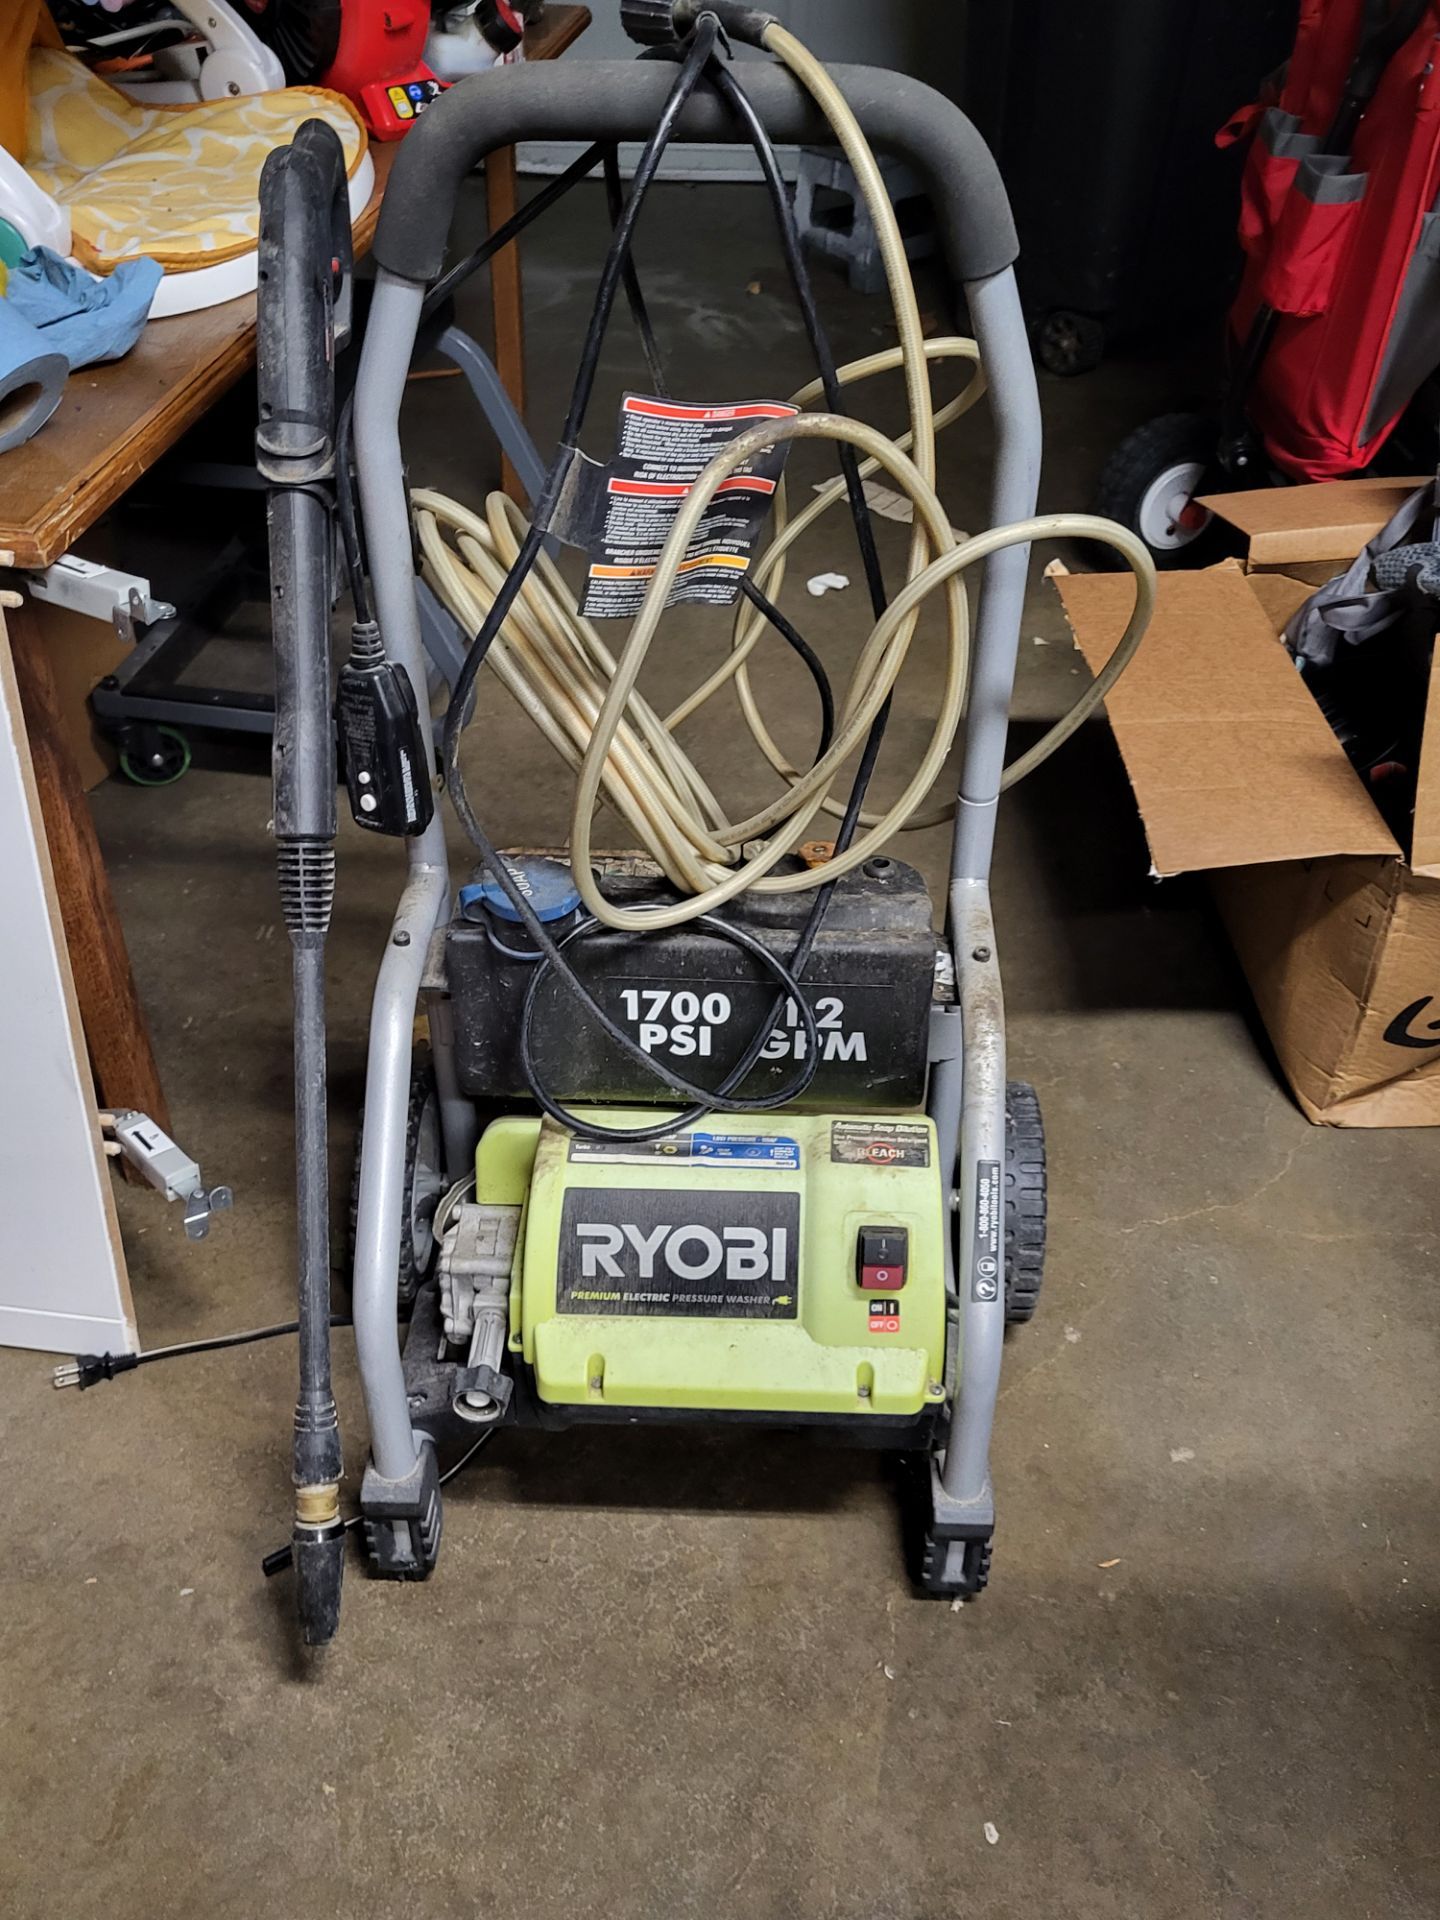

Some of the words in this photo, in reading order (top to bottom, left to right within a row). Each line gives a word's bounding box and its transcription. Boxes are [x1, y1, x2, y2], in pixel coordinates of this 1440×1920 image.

[619, 990, 731, 1025] 1700
[639, 1024, 712, 1056] PSI
[873, 1123, 895, 1133] Soap
[979, 1178, 990, 1238] 1-800-860-4050
[990, 1167, 999, 1251] www.ryobitools.com
[576, 1223, 787, 1282] RYOBI
[570, 1291, 621, 1301] PREMIUM
[623, 1292, 671, 1303] ELECTRIC
[672, 1293, 724, 1304] PRESSURE
[726, 1295, 771, 1305] WASHER
[871, 1304, 883, 1312] ON
